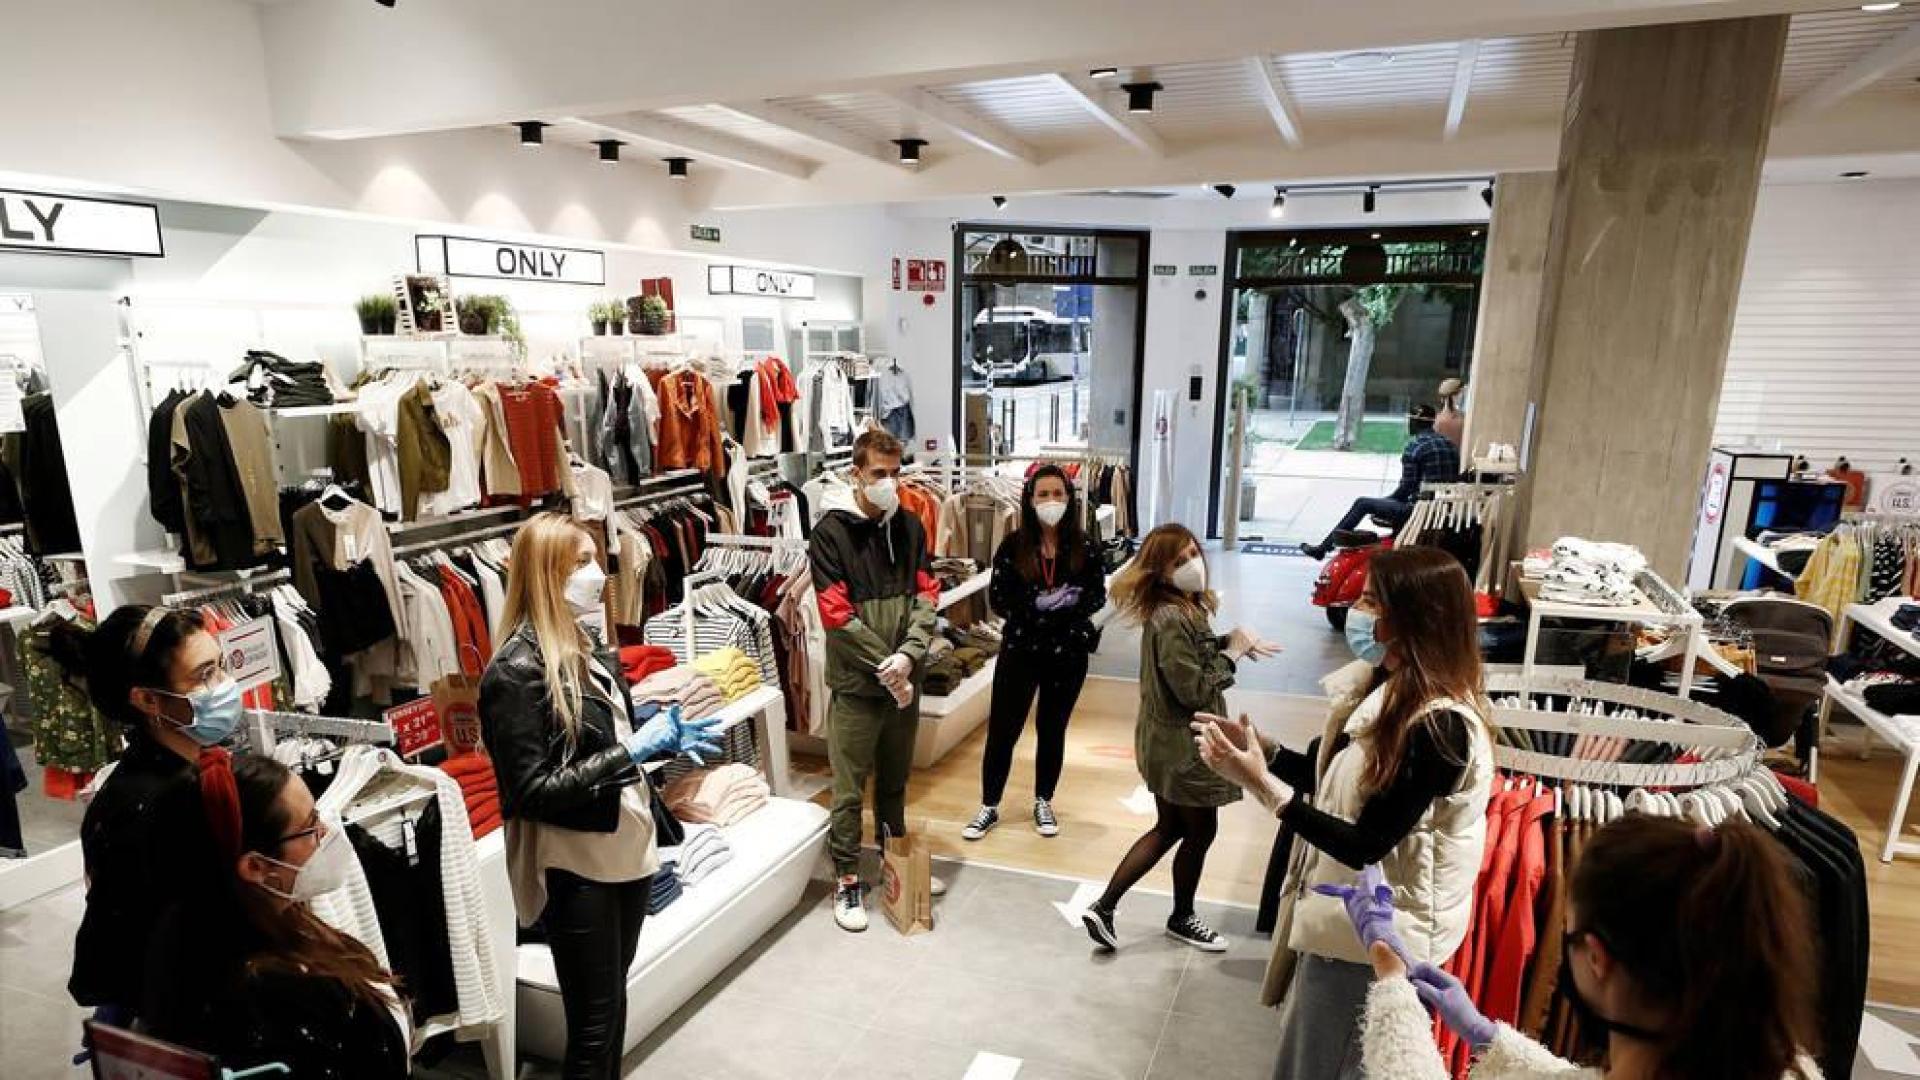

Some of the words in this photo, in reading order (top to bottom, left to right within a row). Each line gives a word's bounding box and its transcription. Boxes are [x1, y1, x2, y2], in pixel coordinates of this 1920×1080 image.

[0, 198, 63, 241] LY
[496, 247, 566, 277] ONLY
[757, 272, 795, 294] ONLY
